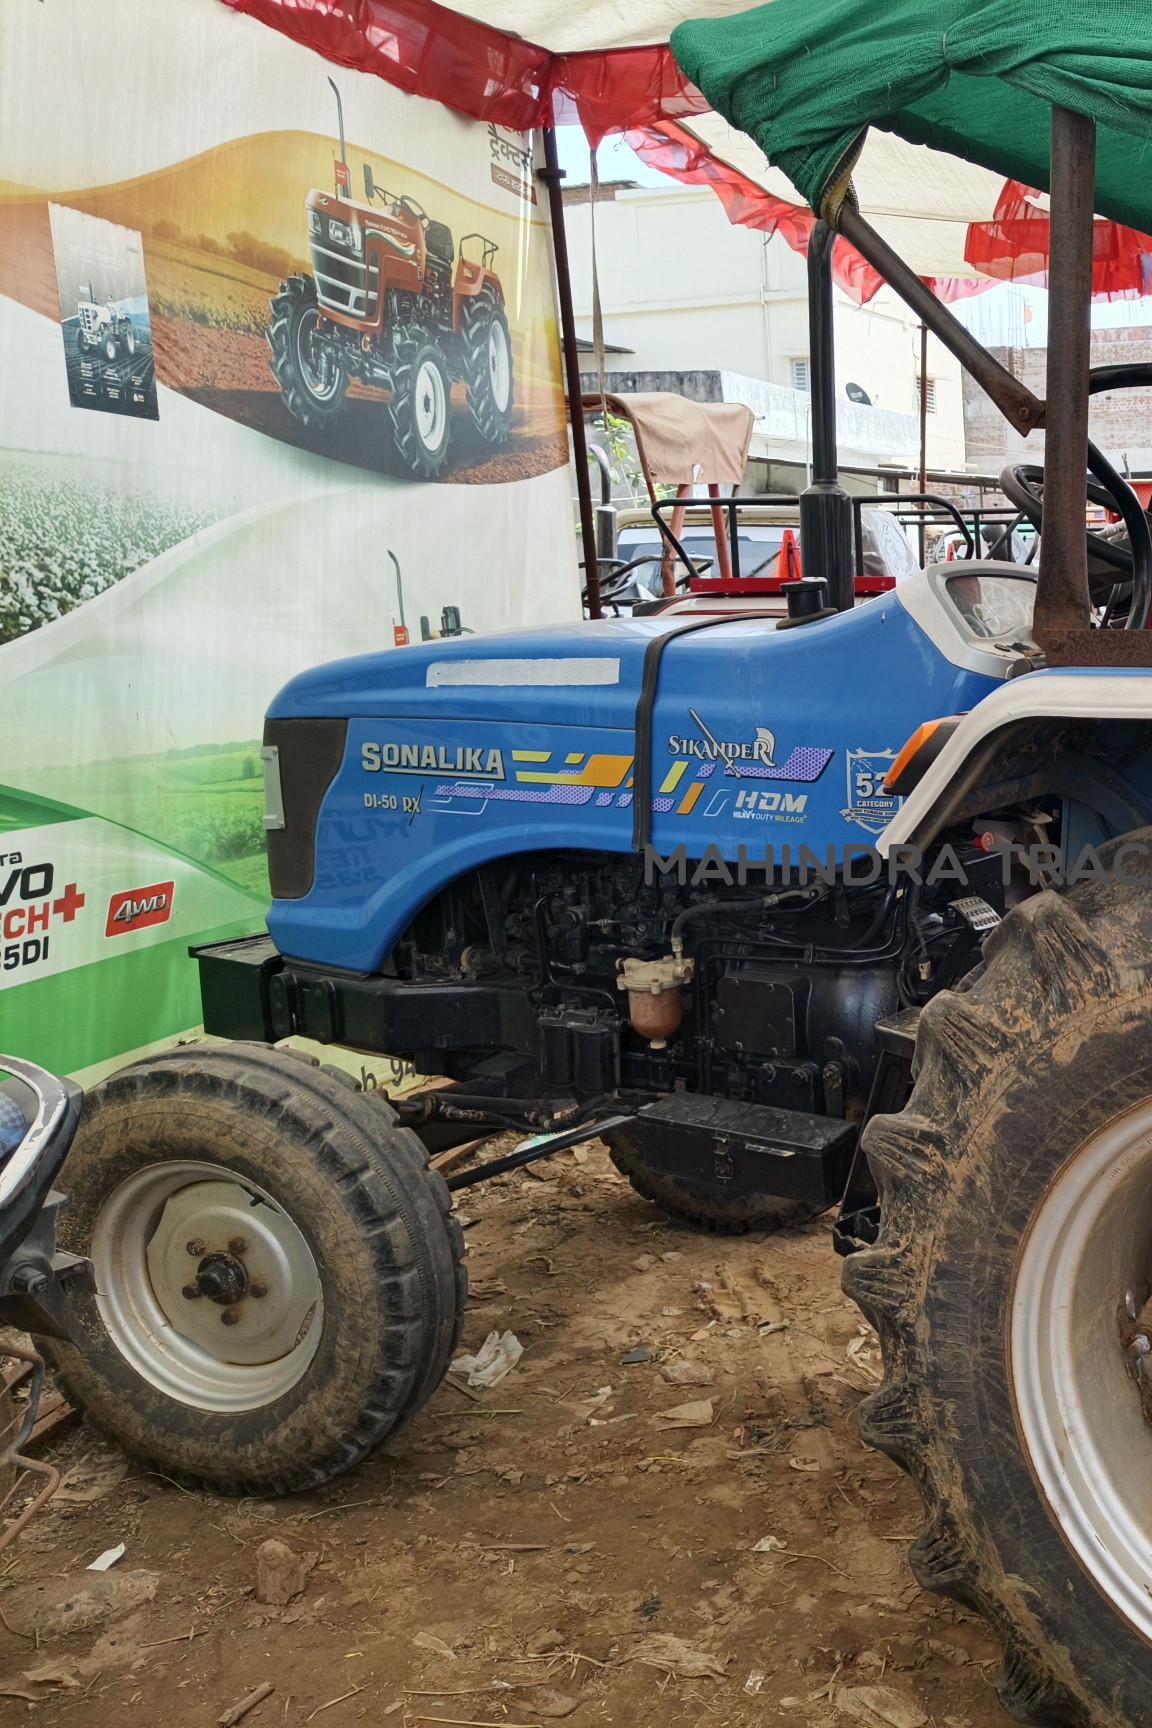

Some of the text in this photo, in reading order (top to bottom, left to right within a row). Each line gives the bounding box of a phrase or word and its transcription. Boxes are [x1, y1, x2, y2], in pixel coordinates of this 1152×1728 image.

[361, 742, 506, 780] SONALIKA
[364, 793, 397, 810] DI-50
[735, 790, 808, 813] HDM
[856, 800, 894, 808] CATEGORY
[113, 893, 167, 923] 4WD
